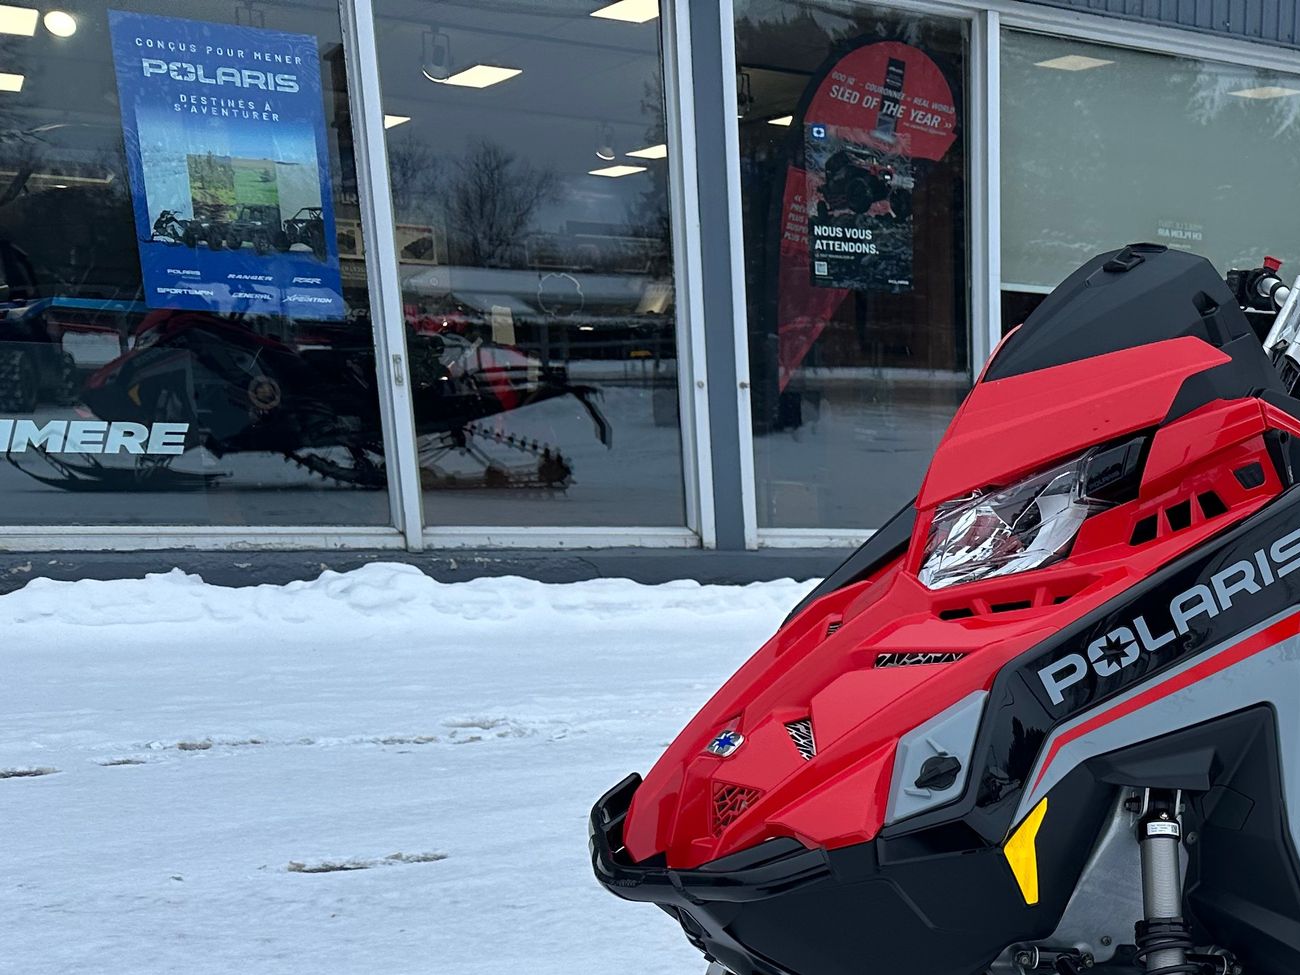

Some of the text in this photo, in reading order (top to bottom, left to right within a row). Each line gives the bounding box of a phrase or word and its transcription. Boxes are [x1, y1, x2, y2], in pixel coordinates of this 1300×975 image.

[135, 37, 302, 65] CONÇUS POUR MENER
[142, 58, 300, 93] POLARIS
[174, 103, 279, 122] S'AVENTURER
[829, 85, 860, 104] SLED
[862, 95, 880, 109] OF
[882, 100, 906, 118] THE
[910, 109, 941, 128] YEAR
[814, 225, 843, 238] NOUS
[844, 227, 872, 240] VOUS
[814, 239, 879, 255] ATTENDONS.
[227, 274, 273, 282] RANGER
[157, 287, 214, 296] SPORTSMAN
[232, 292, 272, 300] GENERAL
[0, 419, 190, 455] MERE
